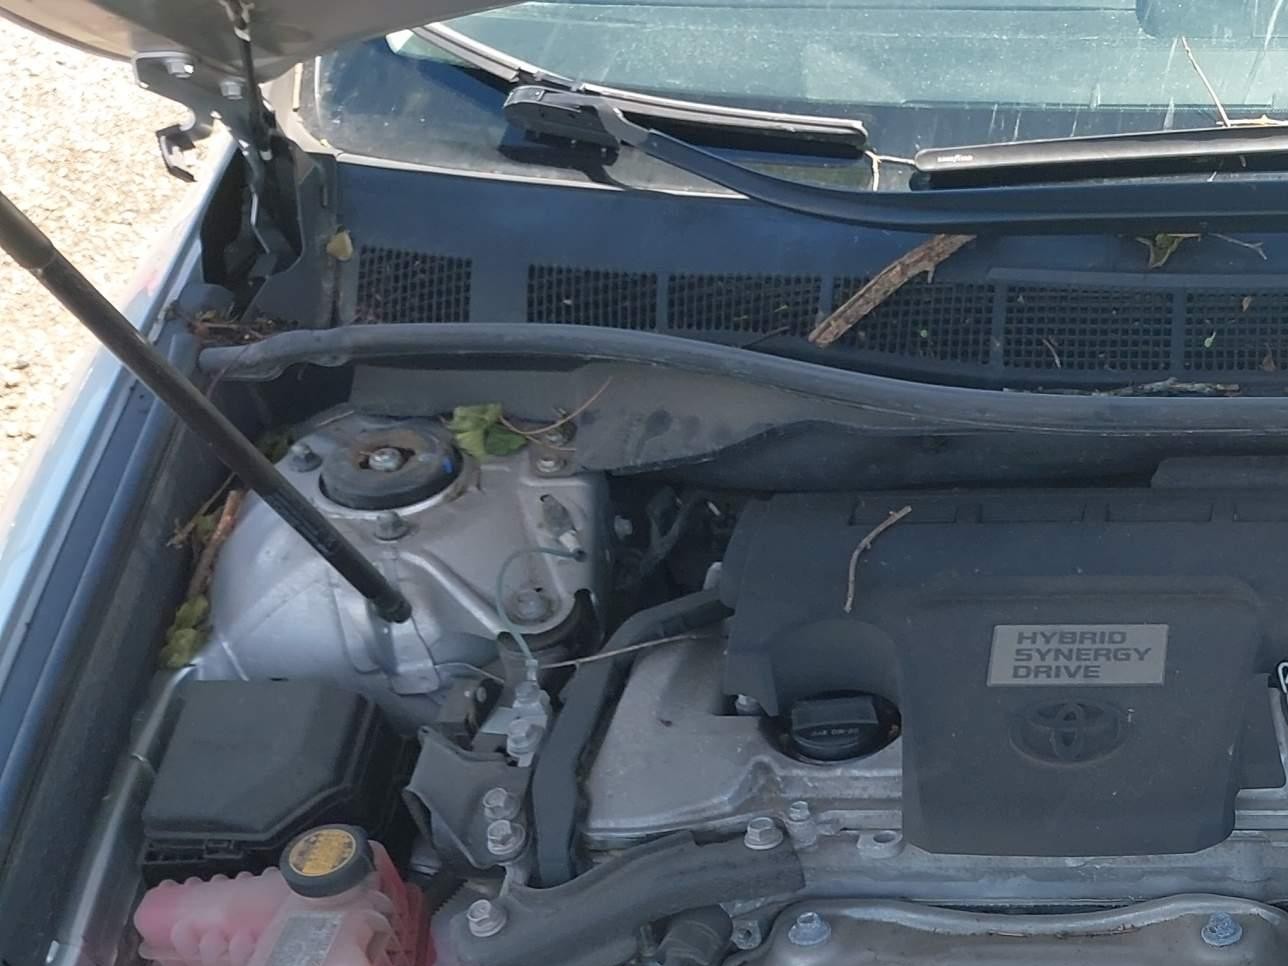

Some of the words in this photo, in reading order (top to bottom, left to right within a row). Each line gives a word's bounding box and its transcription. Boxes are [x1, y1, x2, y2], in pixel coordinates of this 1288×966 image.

[1017, 631, 1127, 644] HYBRID
[1014, 647, 1152, 662] SYNERGY
[1012, 665, 1102, 679] DRIVE
